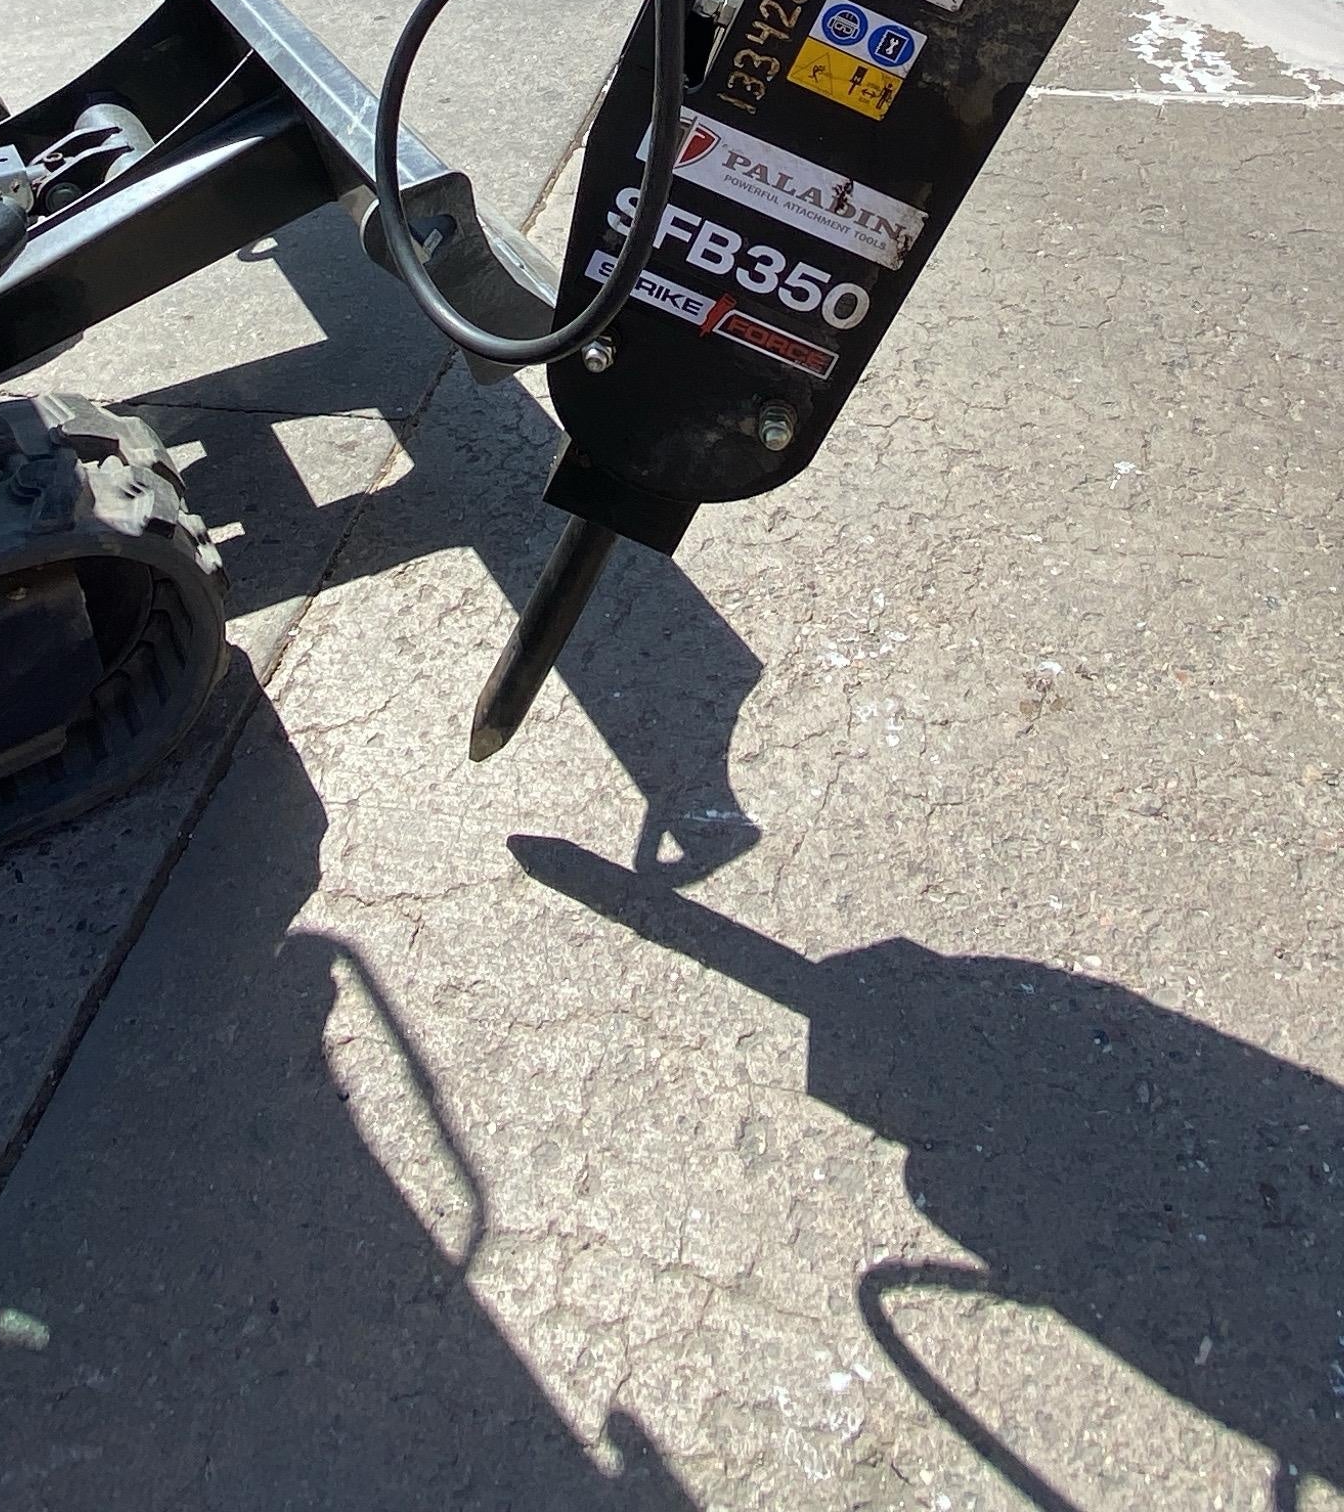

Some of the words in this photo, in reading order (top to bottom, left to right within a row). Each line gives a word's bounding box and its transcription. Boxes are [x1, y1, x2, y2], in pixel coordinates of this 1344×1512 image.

[722, 150, 907, 242] PALADIN
[723, 174, 780, 205] POWERFUL
[782, 201, 852, 235] ATTACHMENT
[853, 230, 887, 251] TOOLS
[607, 187, 870, 330] SFB350
[598, 259, 705, 318] SRIKE
[726, 317, 828, 372] FORCE
